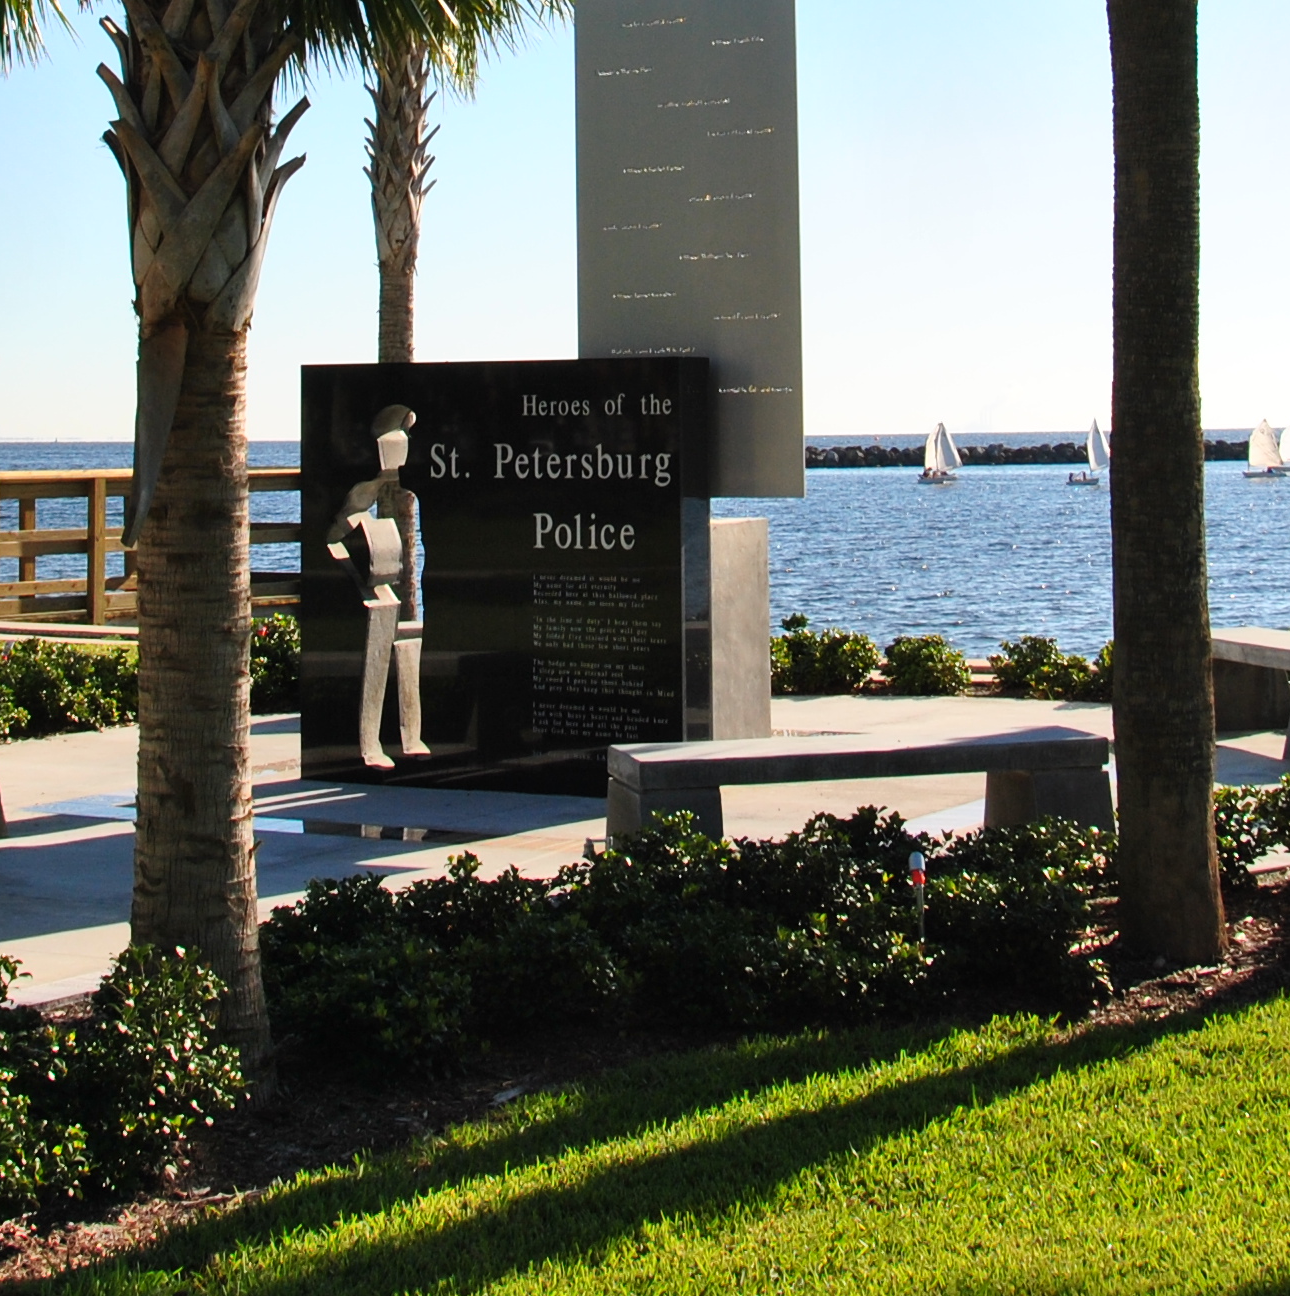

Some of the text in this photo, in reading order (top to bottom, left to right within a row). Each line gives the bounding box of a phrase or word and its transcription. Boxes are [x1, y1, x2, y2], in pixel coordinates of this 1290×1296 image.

[522, 393, 671, 416] Heroes of the
[430, 443, 671, 487] St. Petersburg
[533, 513, 635, 550] Police
